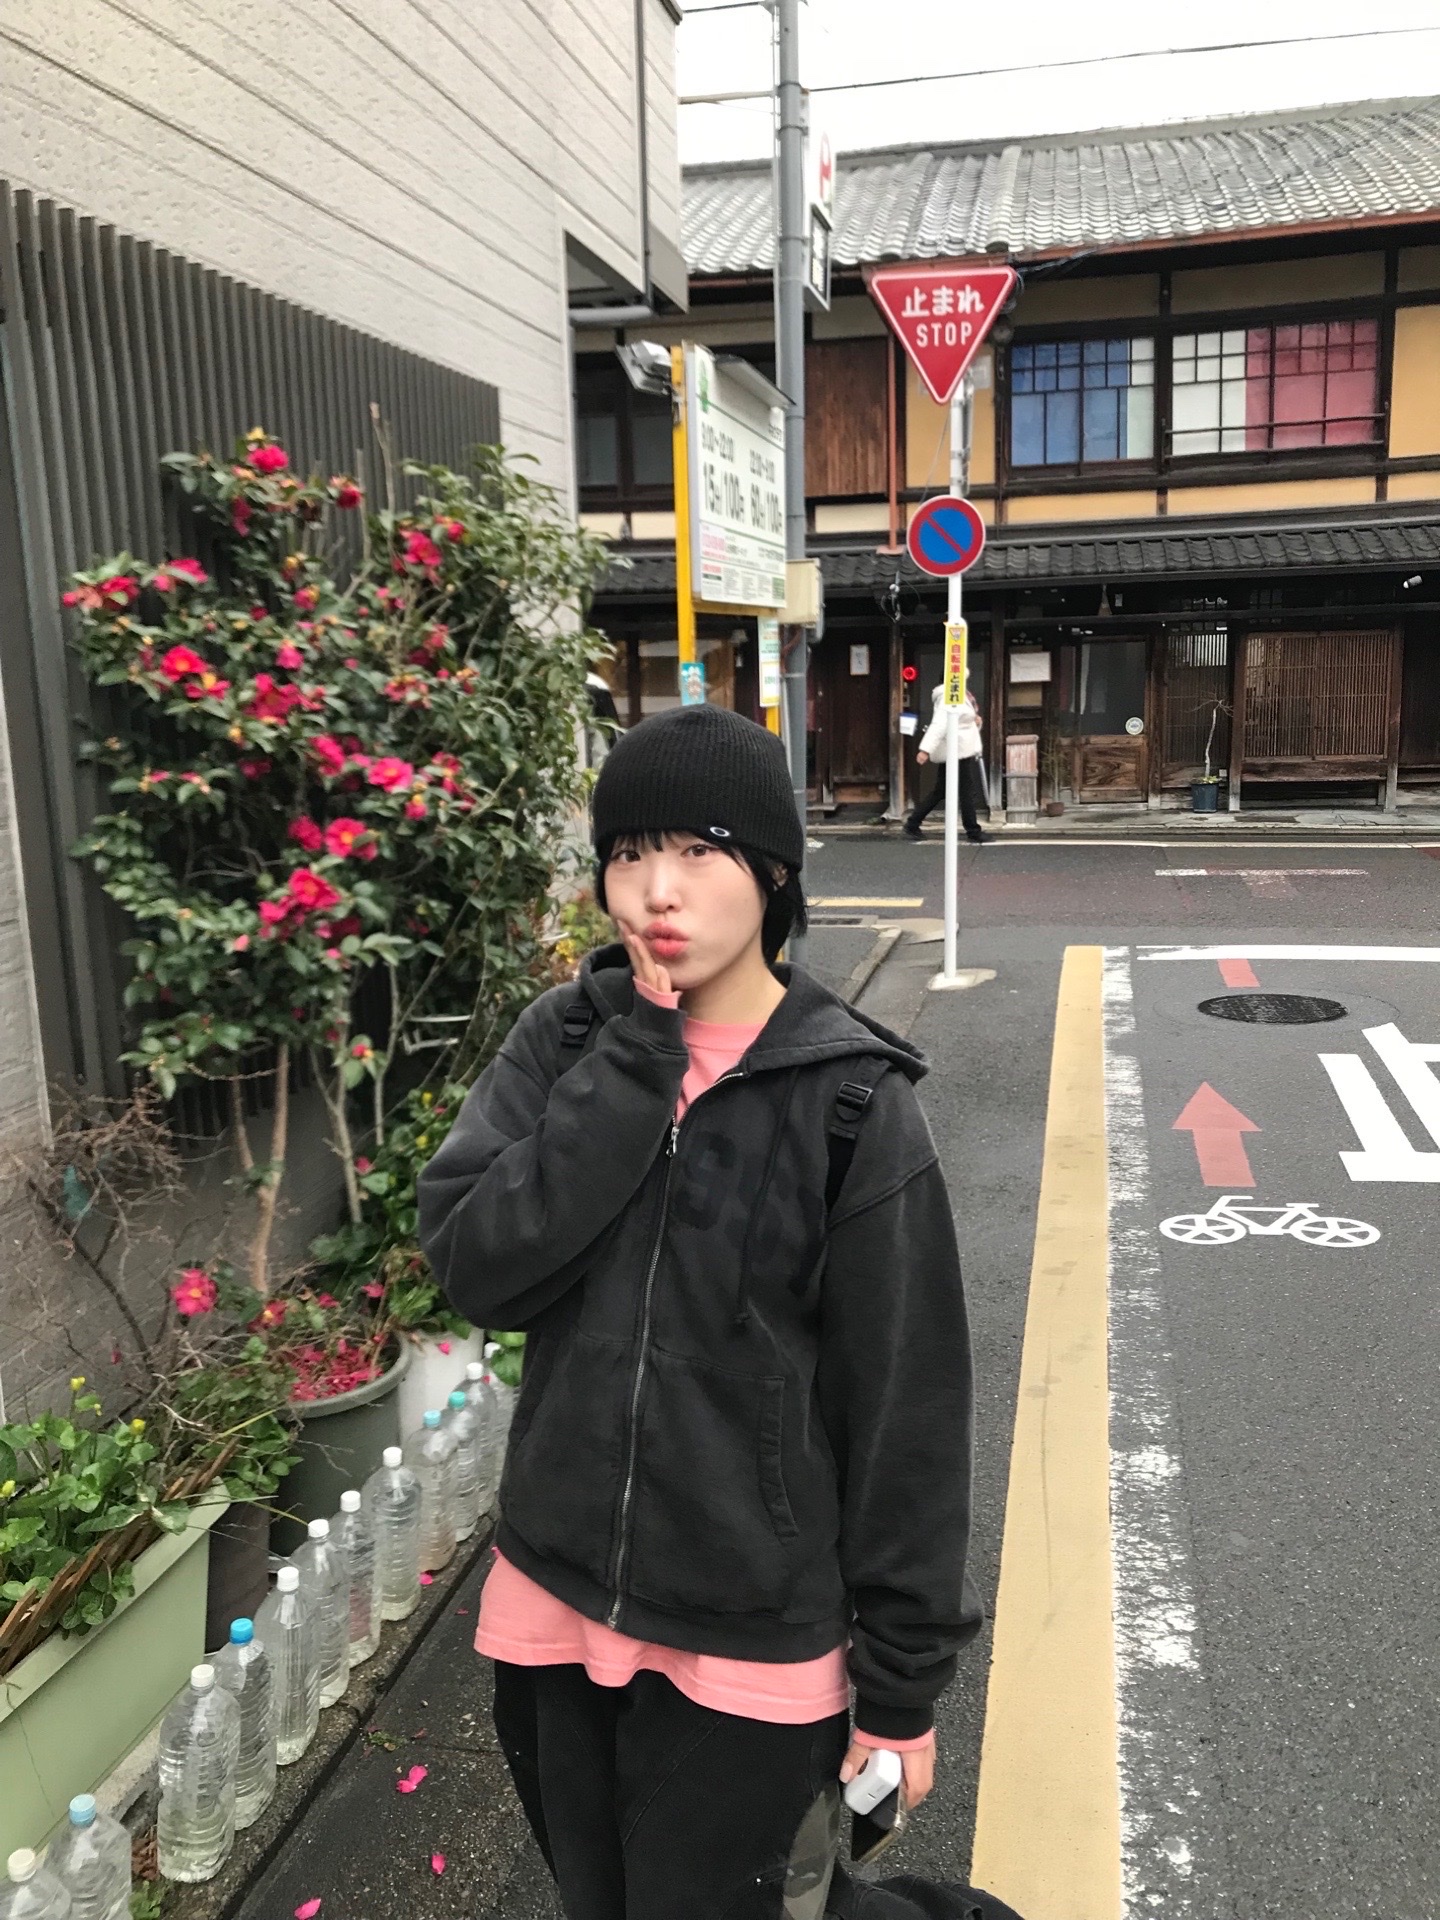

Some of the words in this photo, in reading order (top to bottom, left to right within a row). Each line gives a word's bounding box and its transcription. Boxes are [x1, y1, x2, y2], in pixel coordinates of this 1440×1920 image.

[901, 284, 985, 317] 止まれ
[916, 321, 972, 348] STOP
[949, 644, 961, 702] 自転車とまれ
